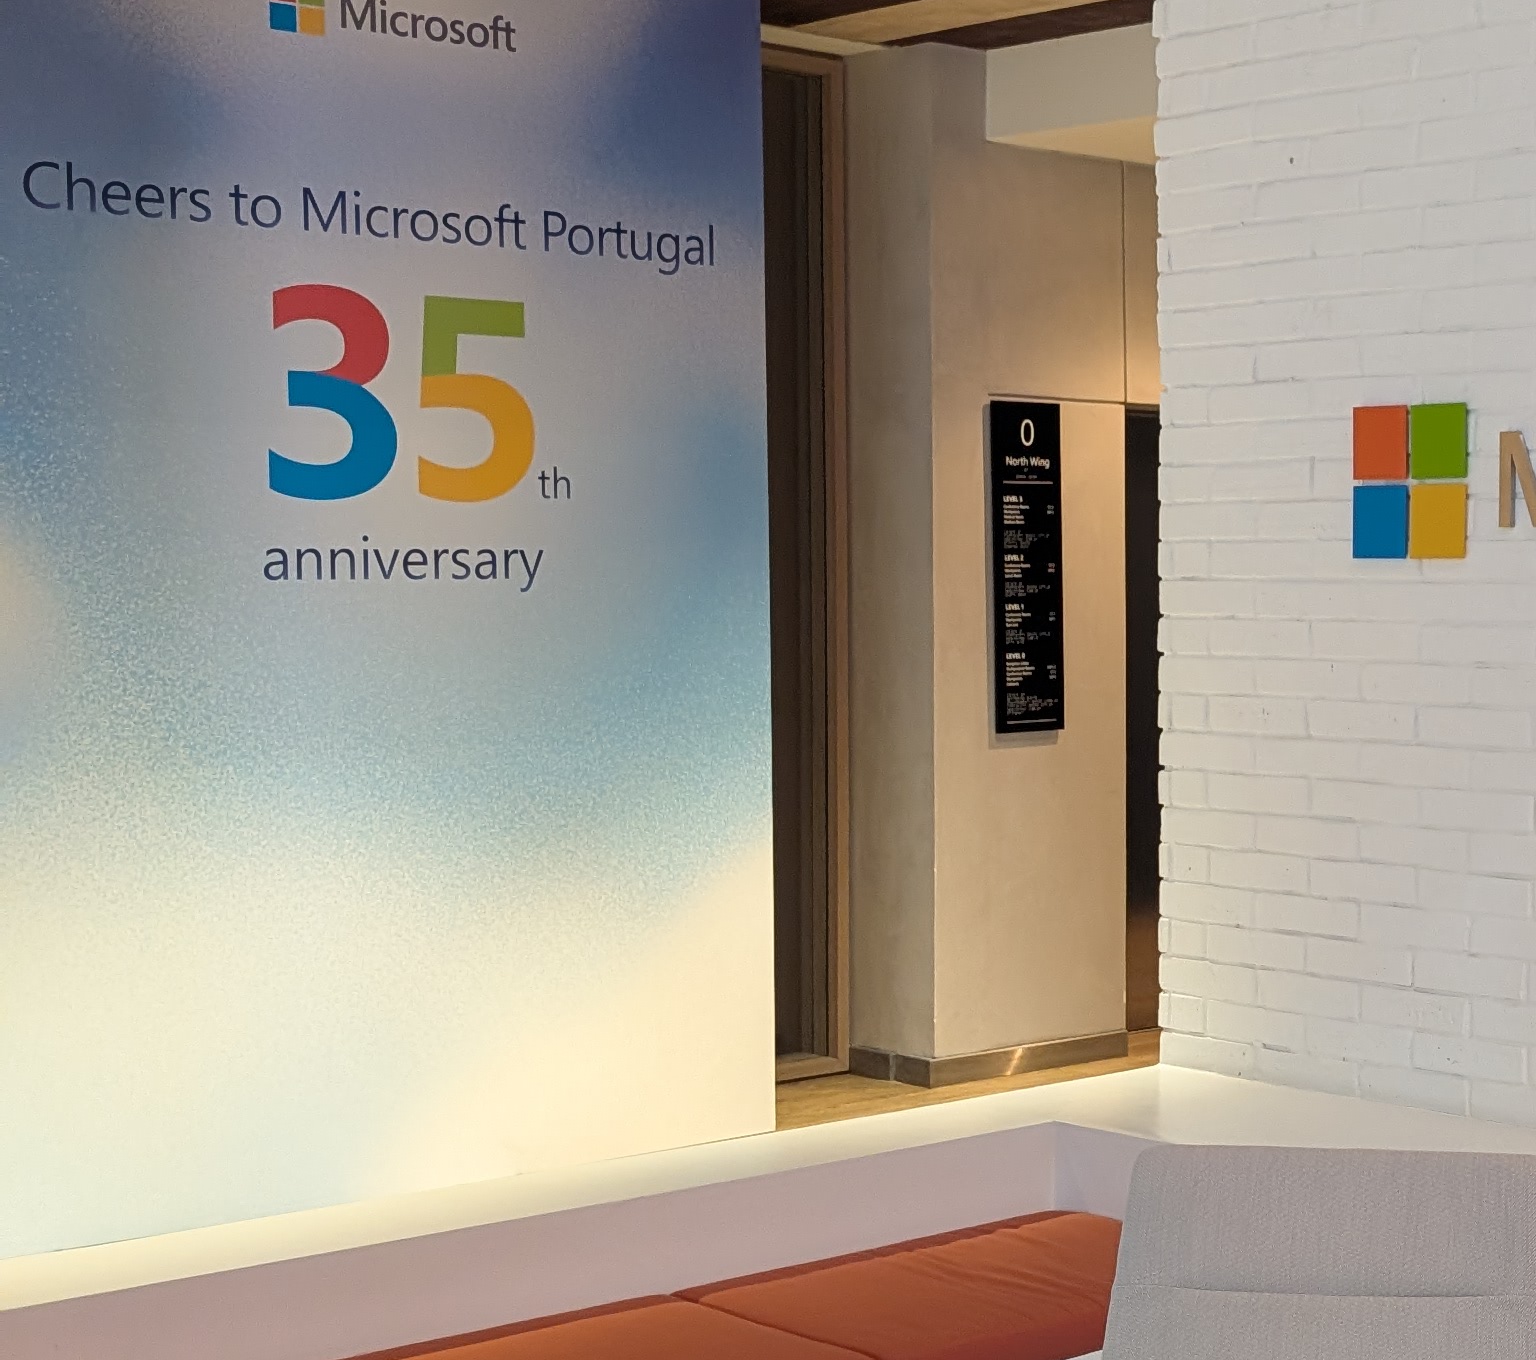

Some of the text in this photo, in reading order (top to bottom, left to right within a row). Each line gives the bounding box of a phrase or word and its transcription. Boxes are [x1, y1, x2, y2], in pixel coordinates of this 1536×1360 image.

[21, 160, 716, 276] Cheers to Microsoft Portugal
[1005, 455, 1051, 470] North Wing
[262, 535, 545, 593] anniversary
